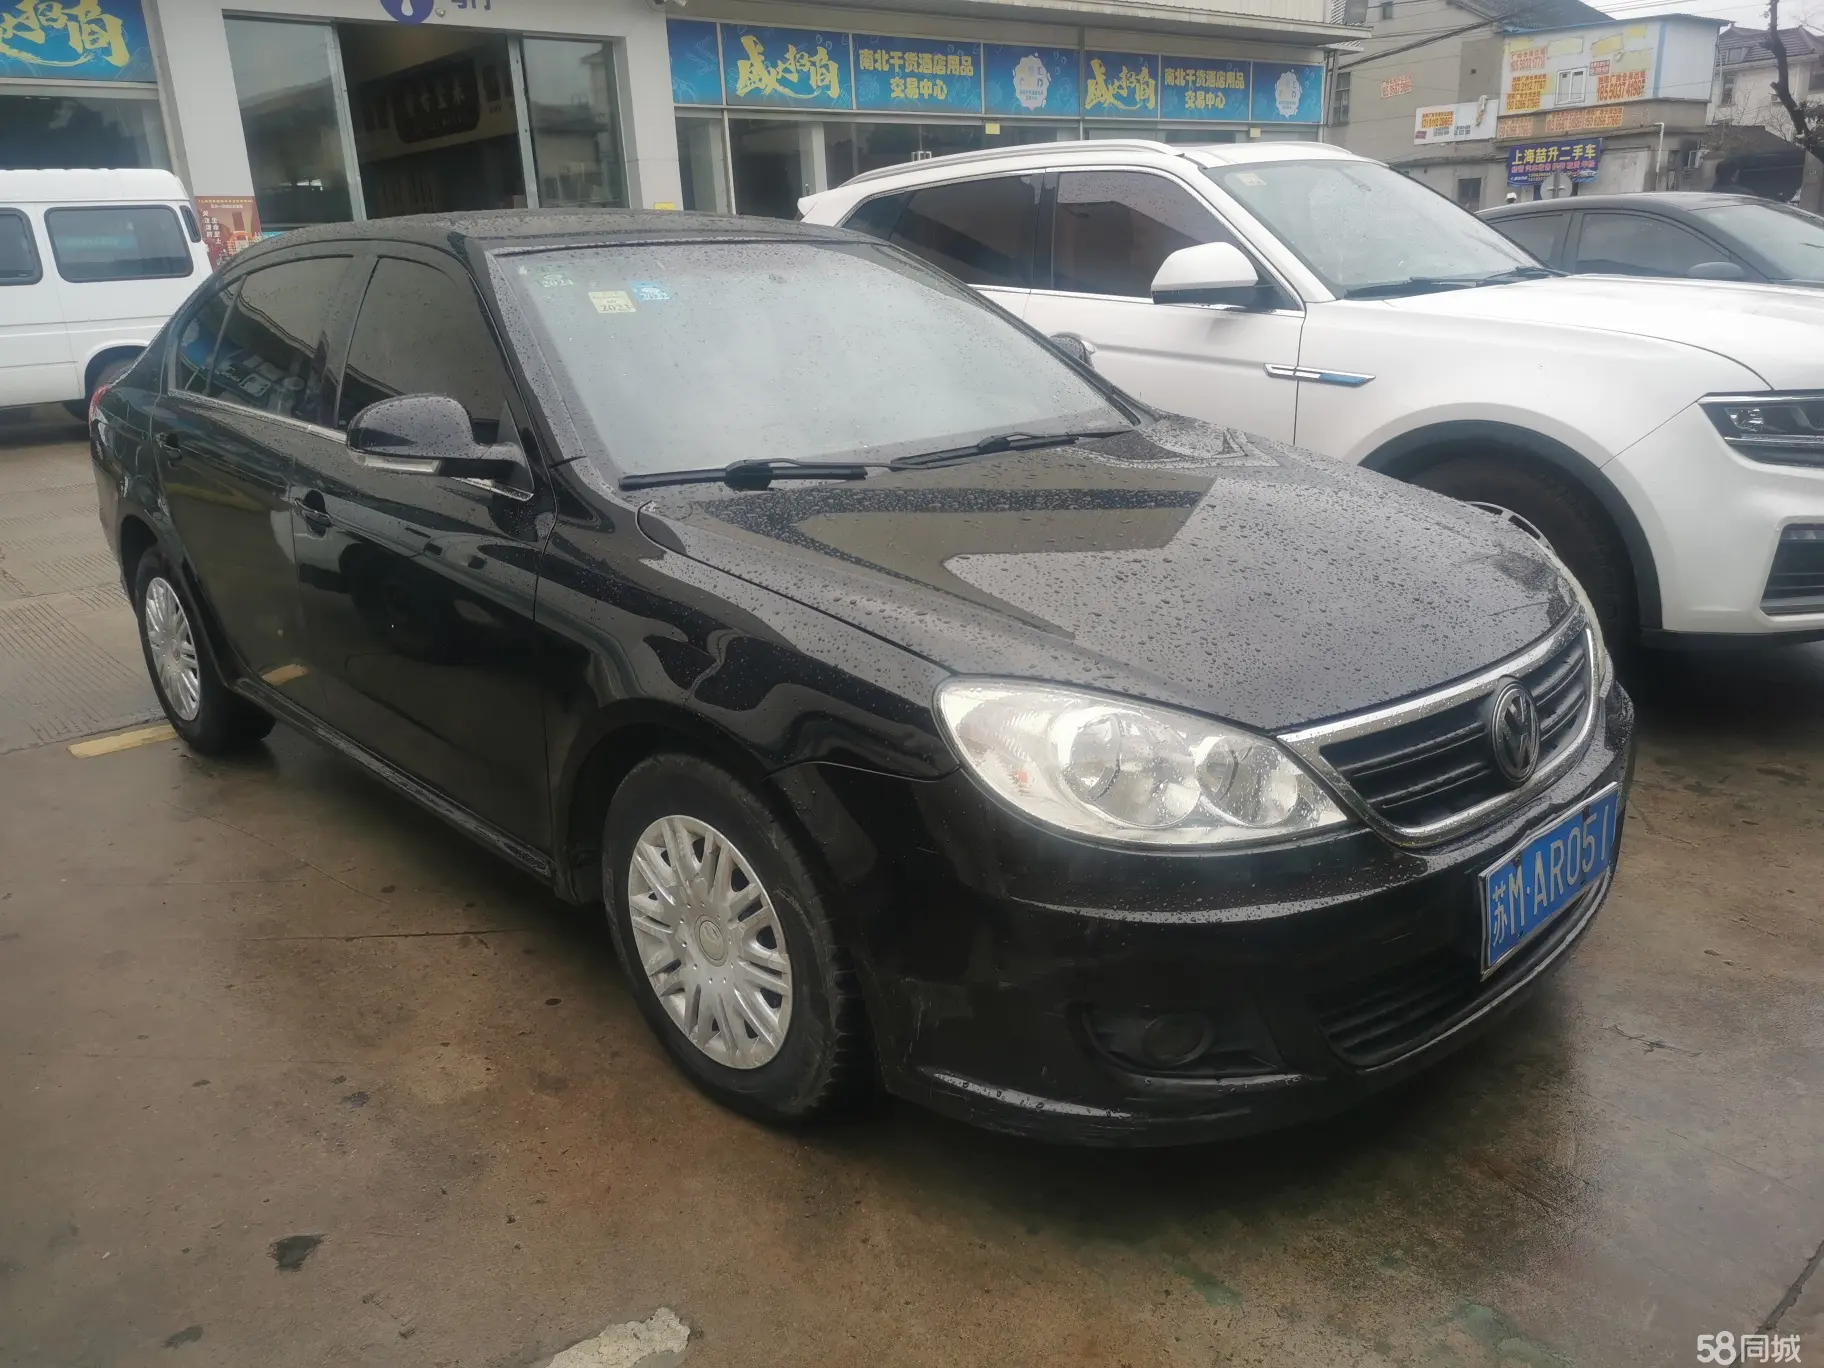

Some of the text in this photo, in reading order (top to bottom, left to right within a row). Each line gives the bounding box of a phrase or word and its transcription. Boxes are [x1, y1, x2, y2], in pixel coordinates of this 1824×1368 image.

[858, 48, 974, 77] 南北干货酒店用品
[890, 76, 948, 100] 交易中心
[1164, 68, 1245, 89] 南北干货酒店用品
[1184, 90, 1226, 110] 交易中心
[1511, 143, 1597, 166] 上海喆升二手车
